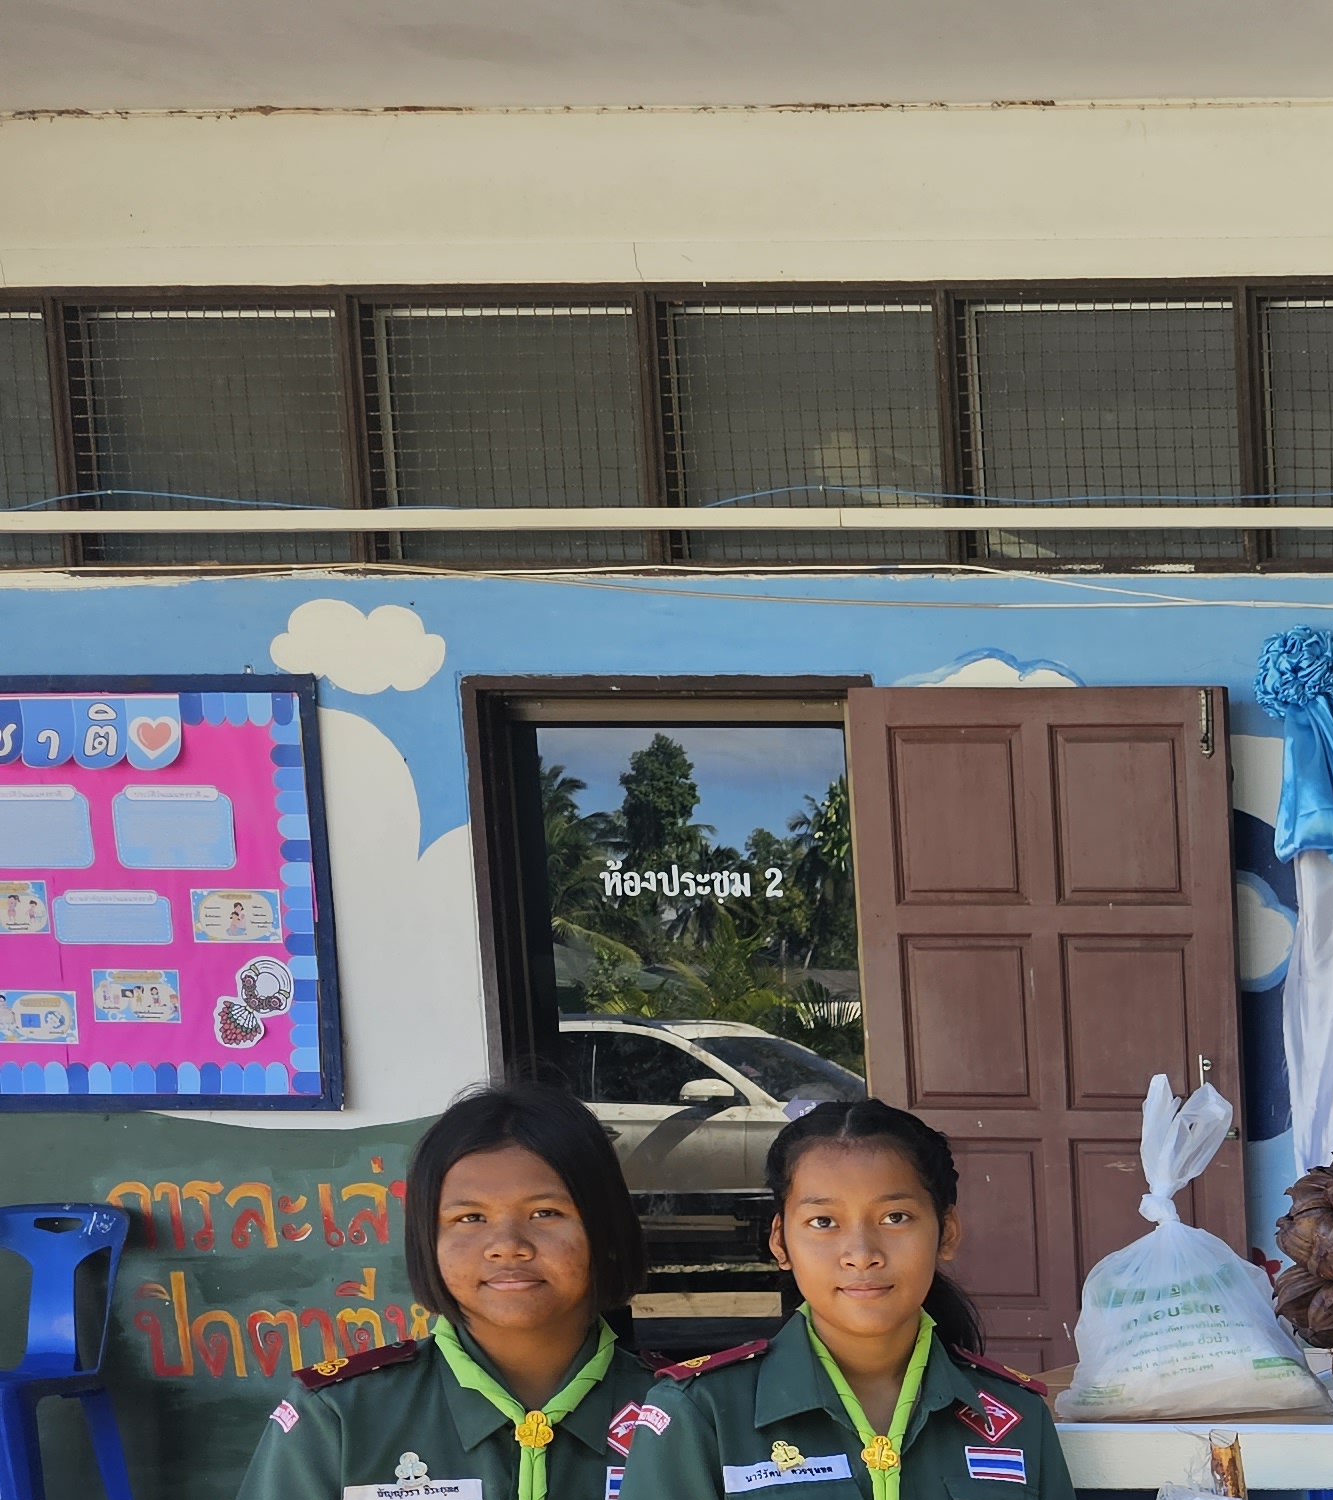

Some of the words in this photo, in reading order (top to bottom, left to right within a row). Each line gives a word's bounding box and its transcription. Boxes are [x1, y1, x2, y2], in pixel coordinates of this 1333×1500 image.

[600, 860, 751, 904] ห้องประชุม
[765, 867, 783, 897] 2
